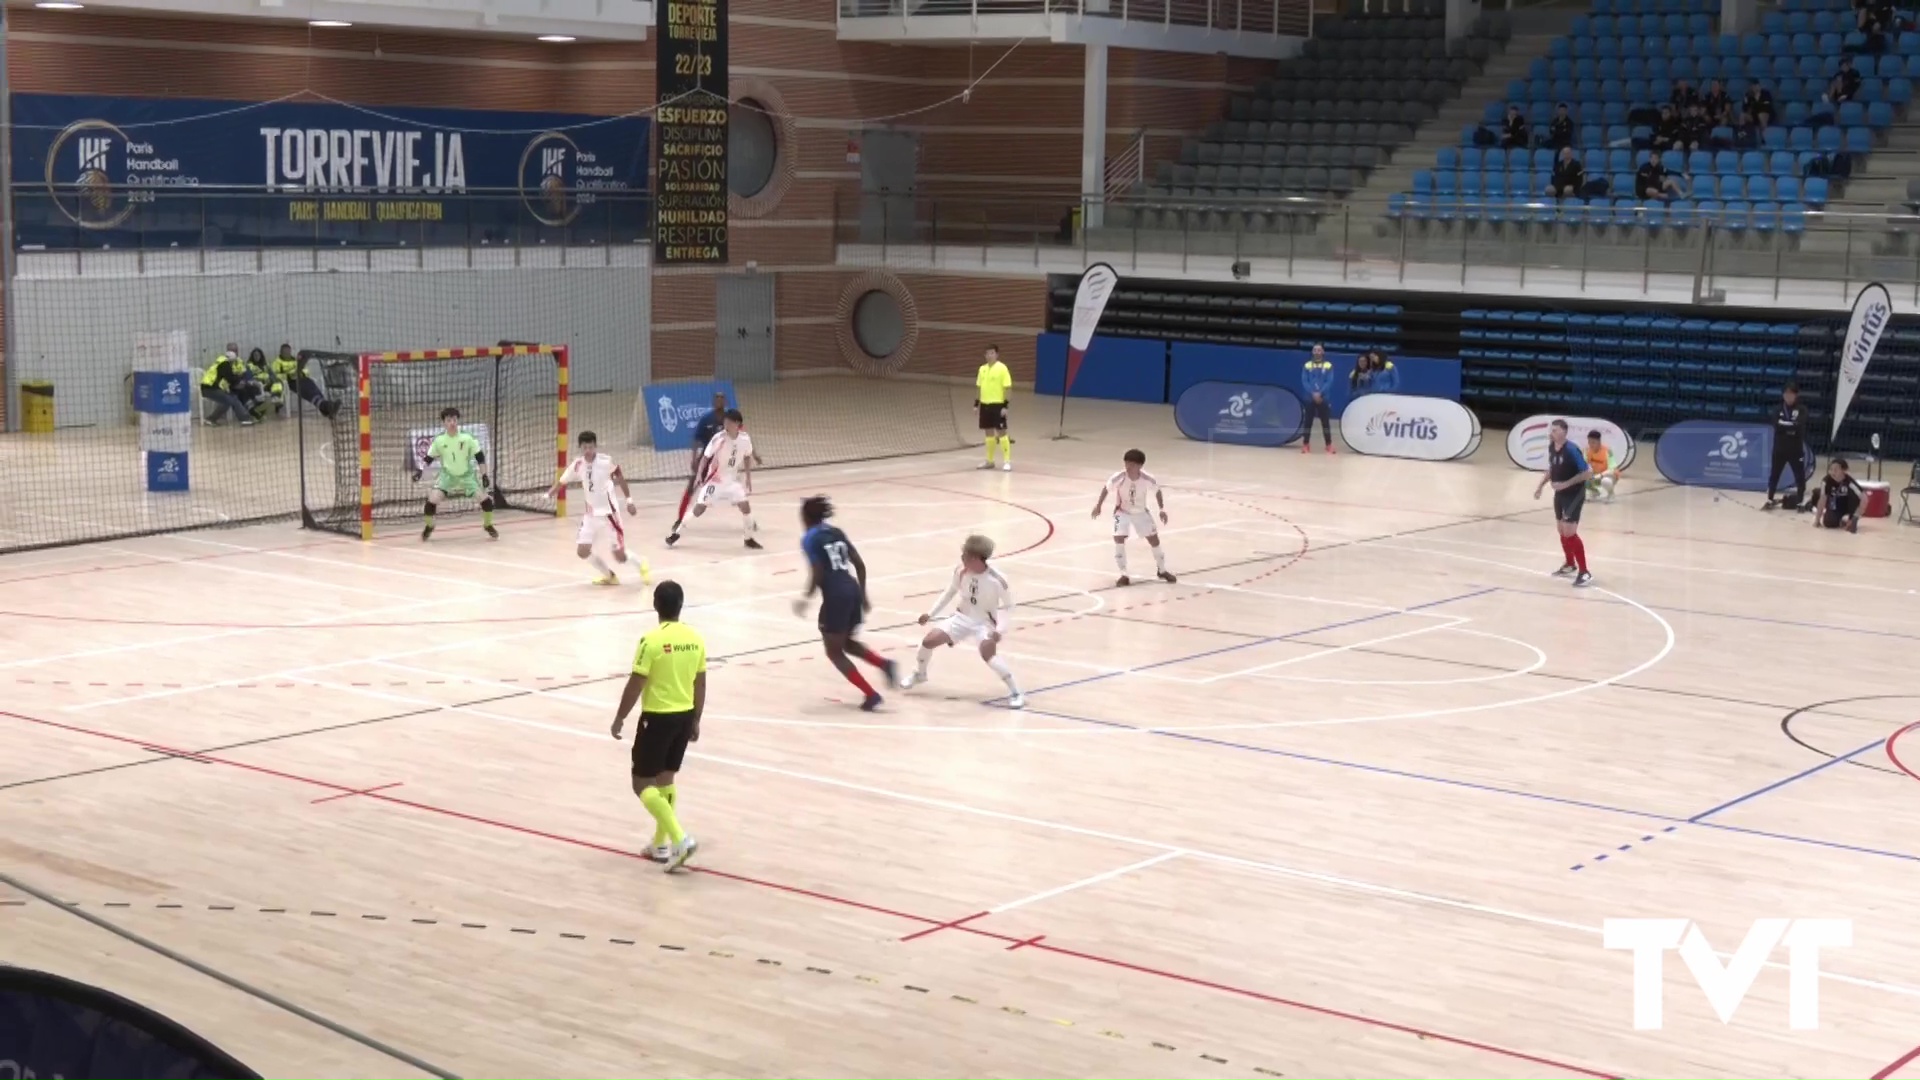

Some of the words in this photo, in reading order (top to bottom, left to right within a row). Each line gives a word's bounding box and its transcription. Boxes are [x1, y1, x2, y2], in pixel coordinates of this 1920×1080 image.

[668, 4, 717, 26] DEPORTE
[675, 53, 711, 75] 22/23
[657, 107, 727, 124] ESFUERZO
[663, 126, 723, 141] DISCIPLINA
[79, 137, 111, 170] IHF
[126, 141, 153, 154] Paris
[663, 144, 723, 156] SACRIFICIO
[126, 158, 179, 170] Handball
[260, 127, 467, 194] TORREVIEJA
[542, 148, 566, 176] IHF
[576, 151, 596, 162] Paris
[576, 165, 614, 177] Handball
[658, 155, 725, 180] PASIÓN
[658, 210, 726, 224] HUMILDAD
[658, 226, 727, 244] RESPETO
[666, 247, 719, 259] ENTREGA
[1851, 301, 1886, 364] virtus
[1383, 416, 1438, 440] virtus
